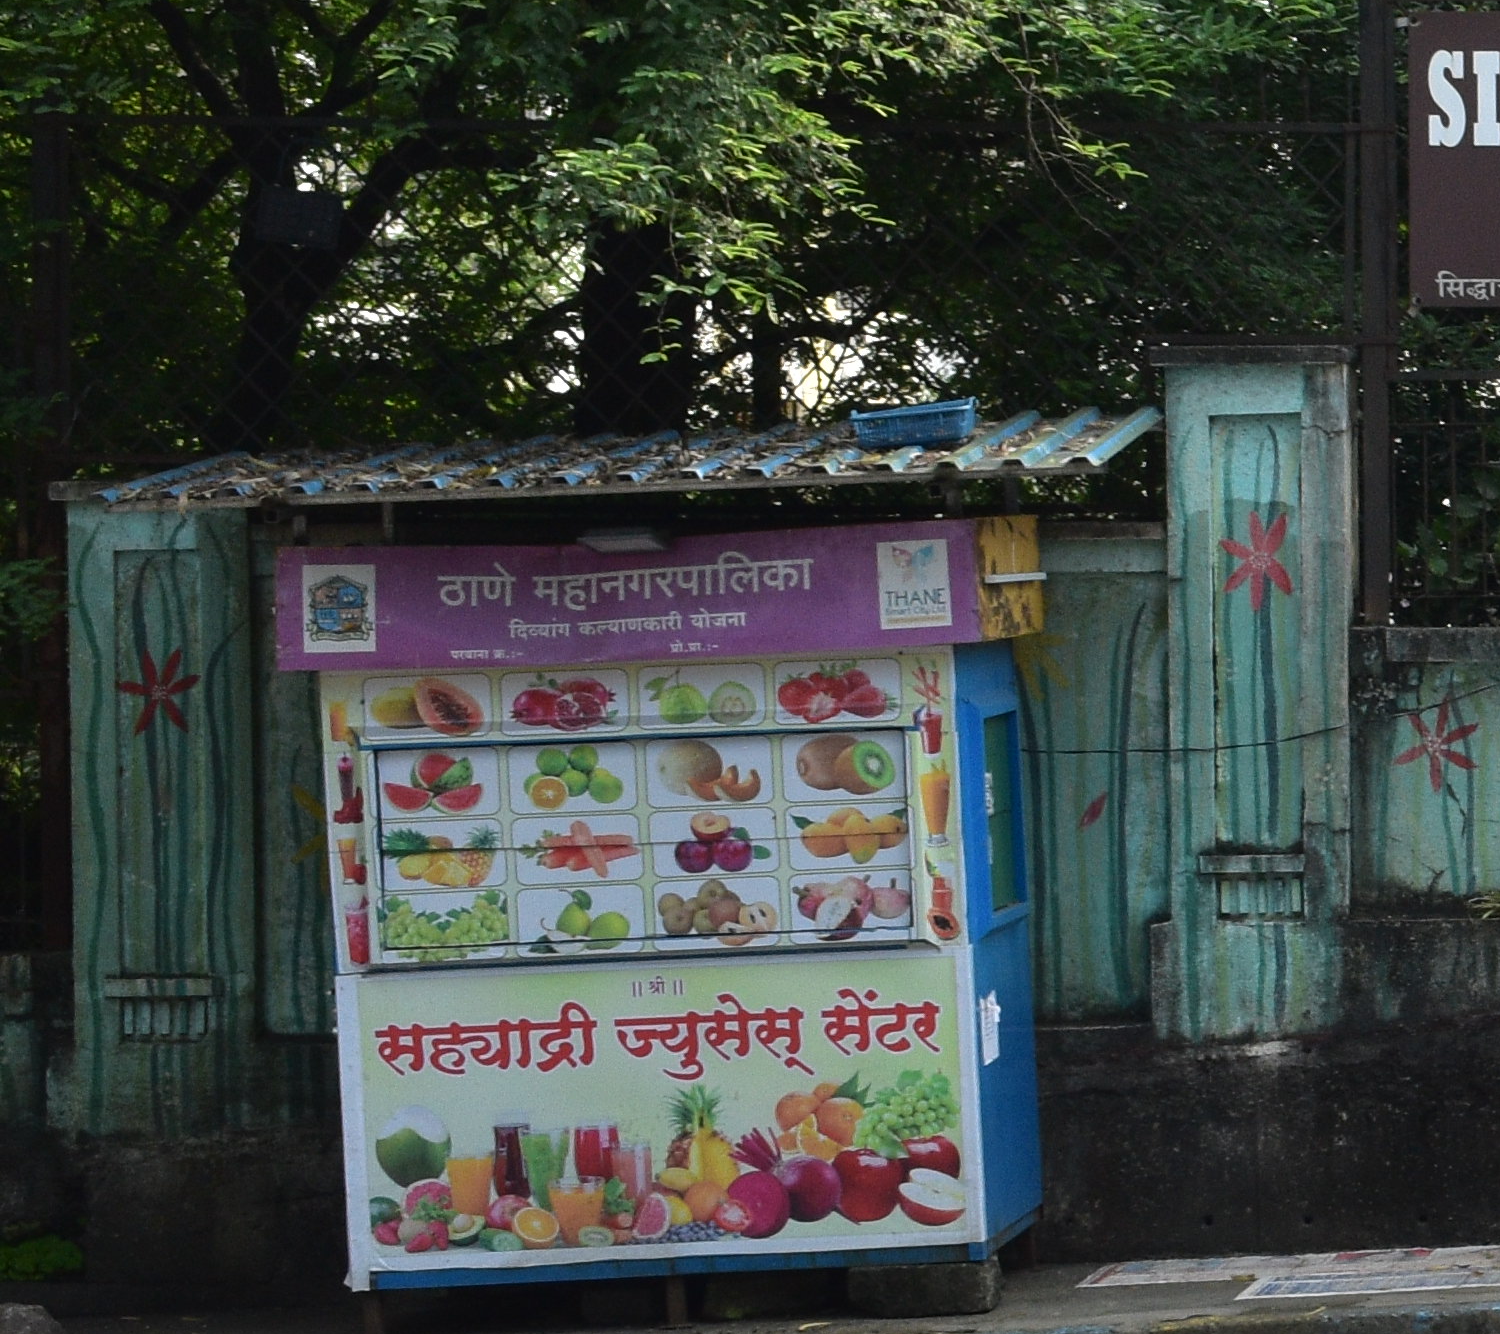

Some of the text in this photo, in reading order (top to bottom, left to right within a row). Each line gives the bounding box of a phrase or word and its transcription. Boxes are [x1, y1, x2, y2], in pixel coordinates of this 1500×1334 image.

[437, 550, 814, 611] ठाणे महानगरपालिका
[885, 588, 946, 606] THANE
[508, 607, 746, 640] दिव्यांग कल्याणकारी योजना
[648, 978, 667, 995] श्री
[373, 999, 598, 1075] सह्याद्री
[613, 992, 815, 1081] ज्युसेस्
[821, 988, 941, 1056] सेंटर
